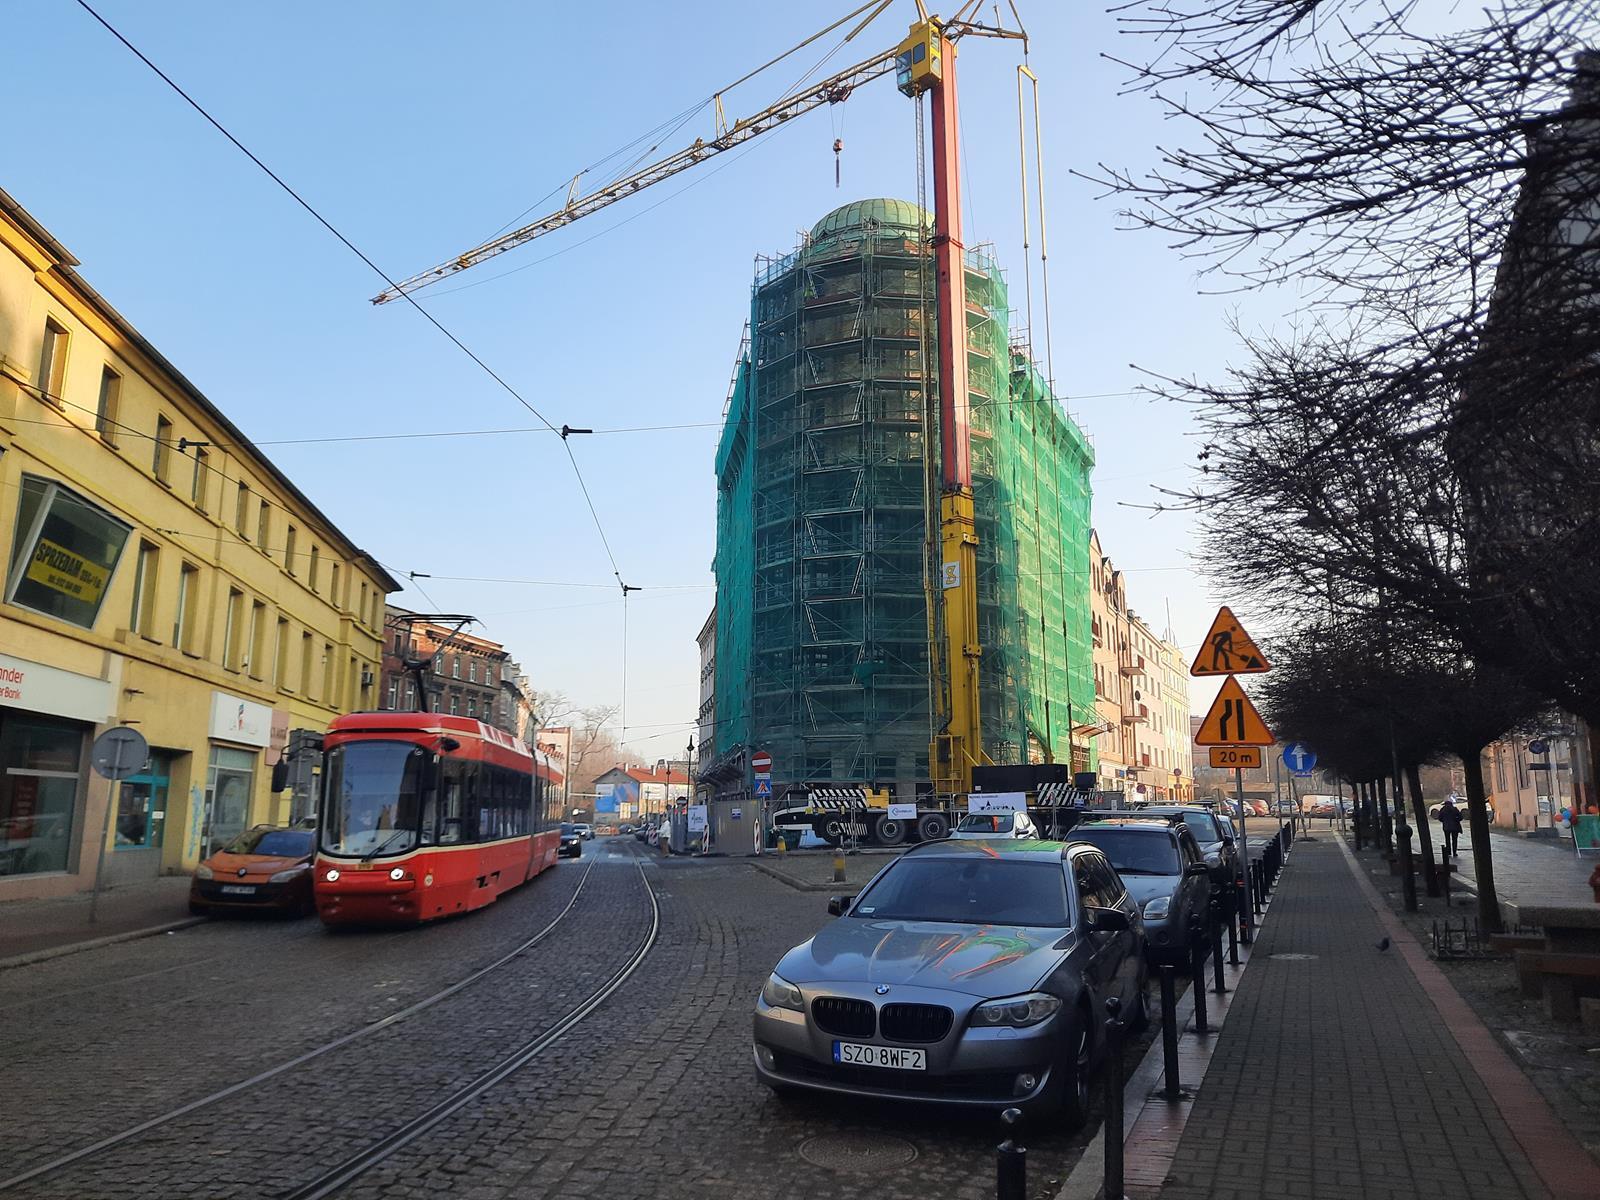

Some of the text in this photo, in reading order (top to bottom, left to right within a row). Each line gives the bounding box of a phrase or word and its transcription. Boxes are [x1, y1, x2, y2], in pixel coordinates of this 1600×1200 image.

[36, 542, 83, 577] SPRZEDAM
[1220, 751, 1252, 763] 20 m
[843, 1045, 874, 1064] SZO
[880, 1048, 922, 1069] 8WF2
